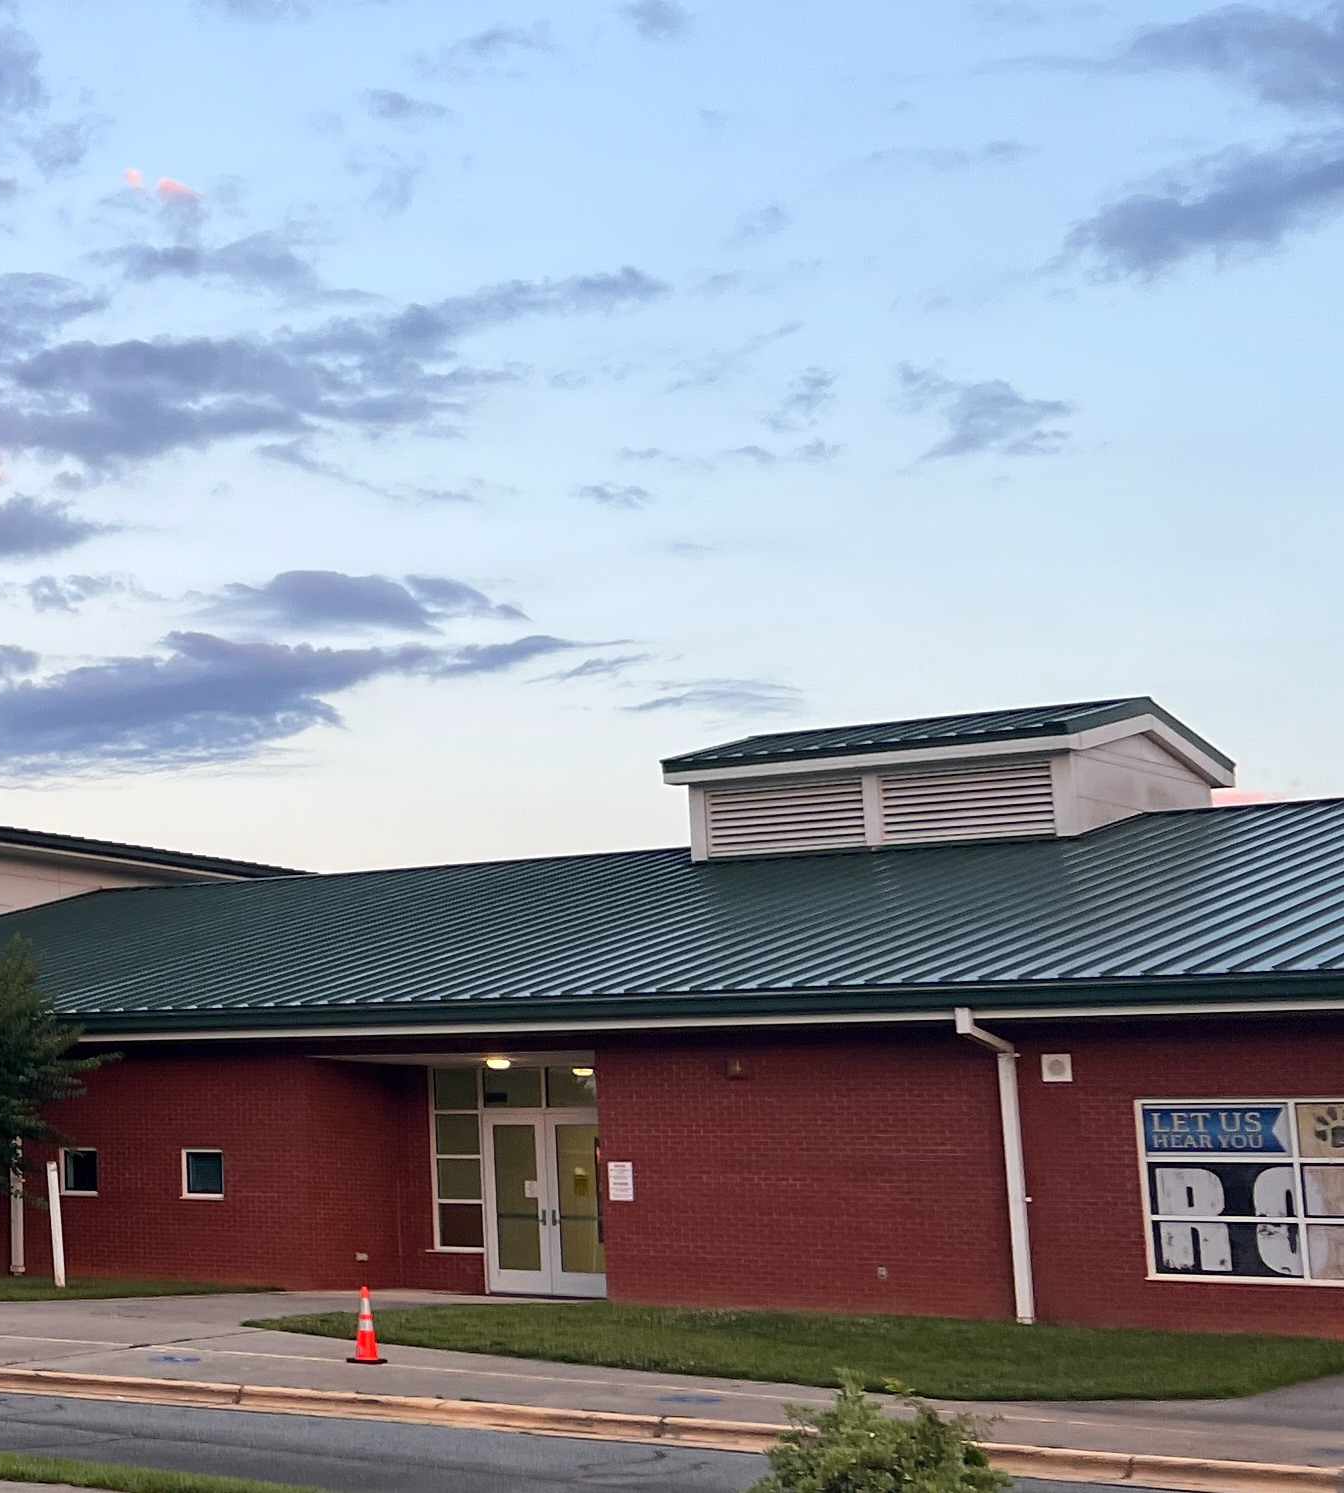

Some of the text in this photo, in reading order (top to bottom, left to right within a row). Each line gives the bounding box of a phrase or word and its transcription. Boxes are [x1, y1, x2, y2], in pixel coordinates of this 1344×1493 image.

[1151, 1111, 1262, 1134] LET US
[1153, 1134, 1263, 1148] HEAR YOU
